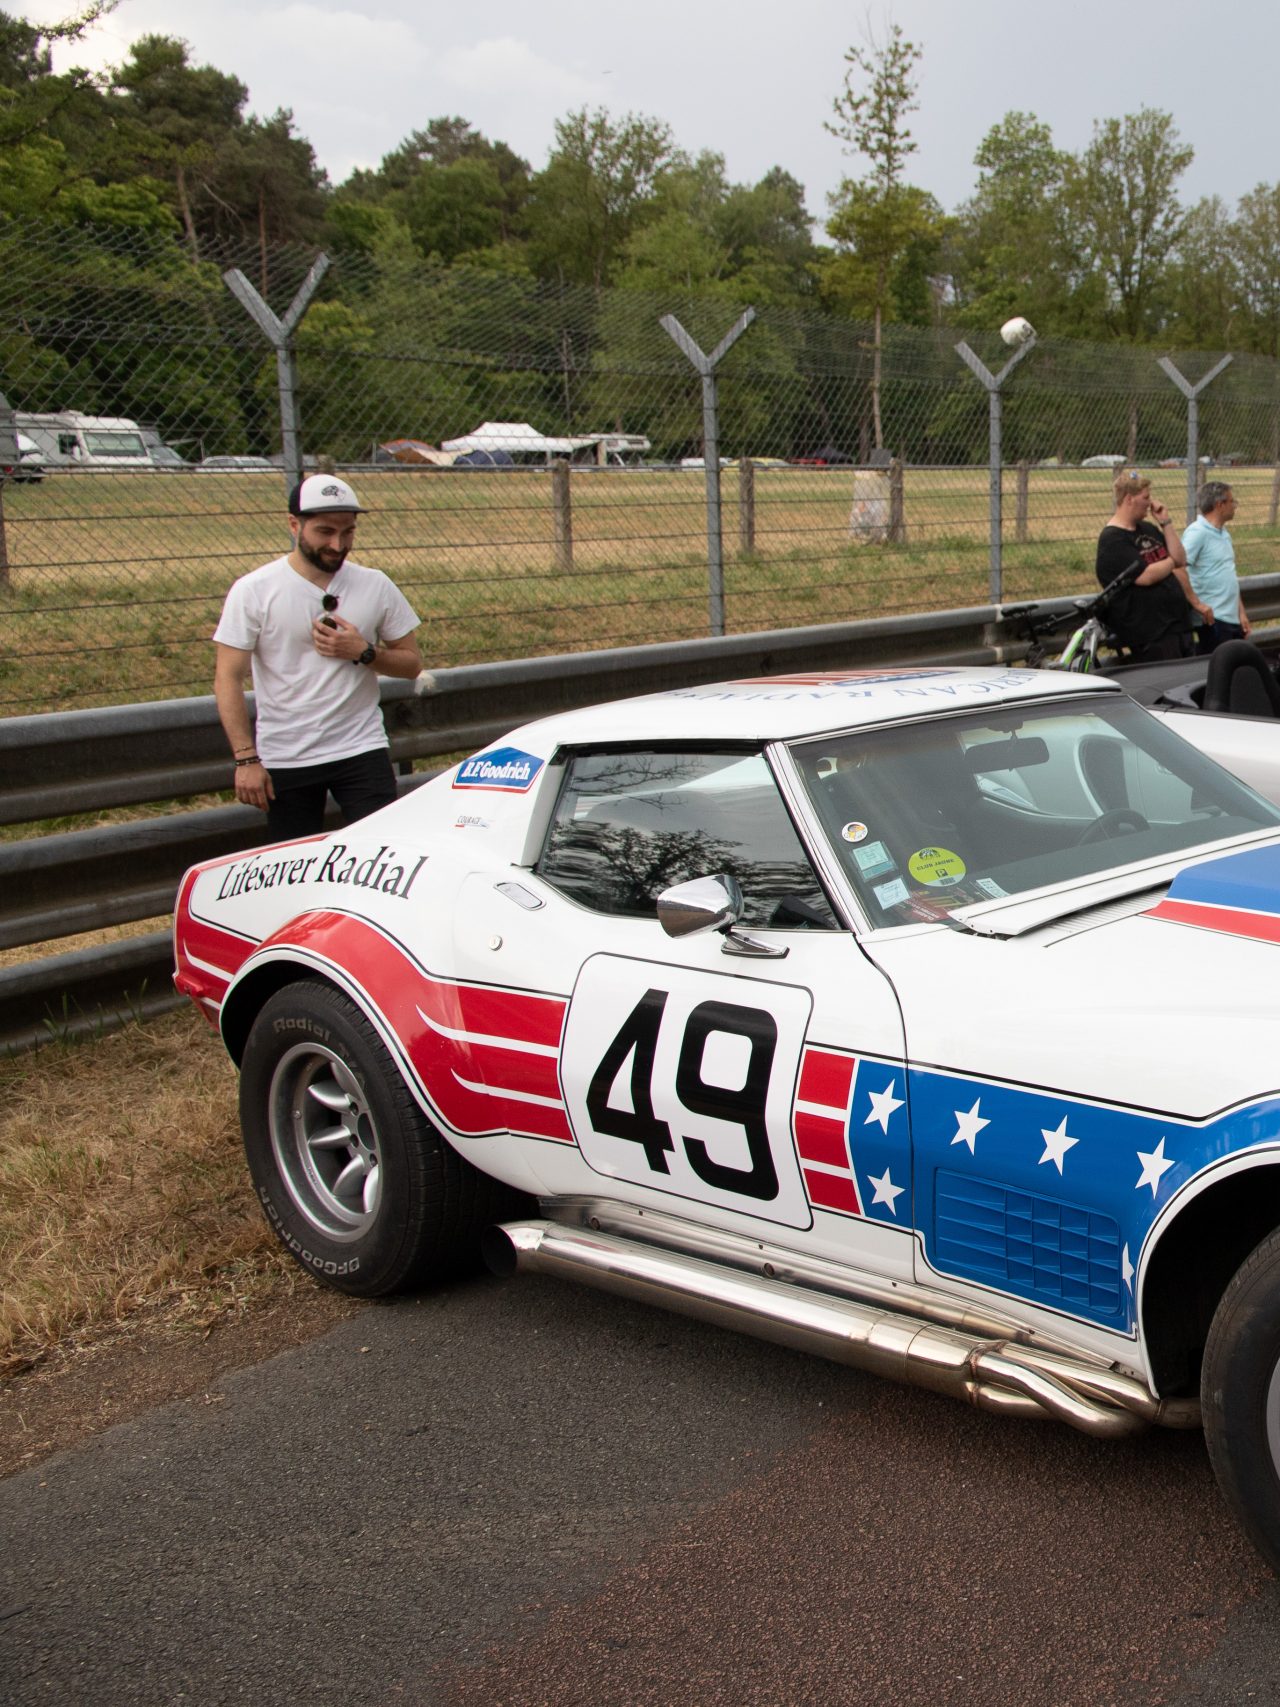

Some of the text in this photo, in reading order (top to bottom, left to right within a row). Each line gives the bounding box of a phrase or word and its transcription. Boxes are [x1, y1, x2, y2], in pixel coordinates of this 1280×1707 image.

[216, 844, 430, 902] Lifesaver Radial
[273, 1016, 332, 1043] Radial
[586, 987, 780, 1202] 49
[258, 1185, 361, 1275] BFGoodrich
